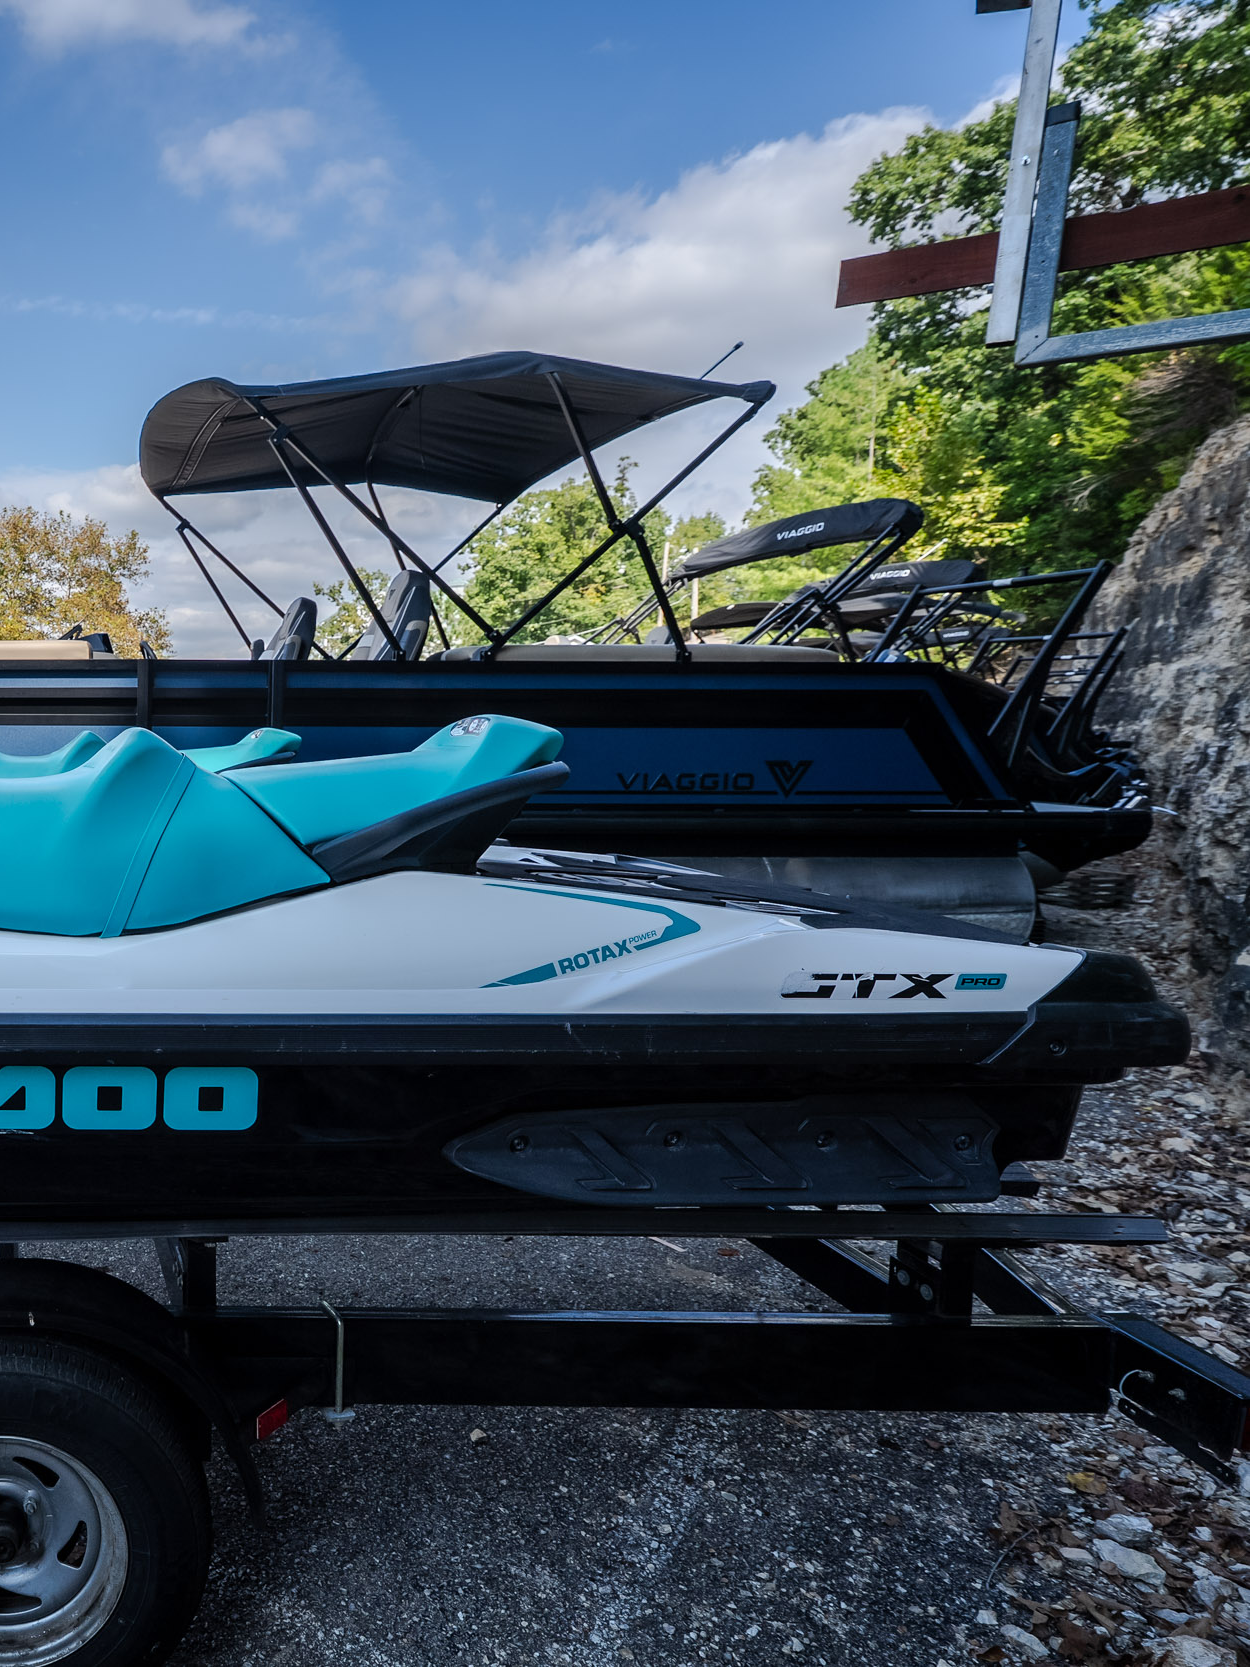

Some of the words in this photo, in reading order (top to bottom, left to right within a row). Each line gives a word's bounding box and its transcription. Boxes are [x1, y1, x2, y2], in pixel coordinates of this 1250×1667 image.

[776, 522, 825, 541] VIAGGIO
[869, 569, 911, 581] VIAGGIO
[616, 772, 755, 791] VIAGGIO
[557, 938, 633, 975] ROTAX
[629, 930, 658, 945] POWER
[960, 977, 1001, 986] PRO
